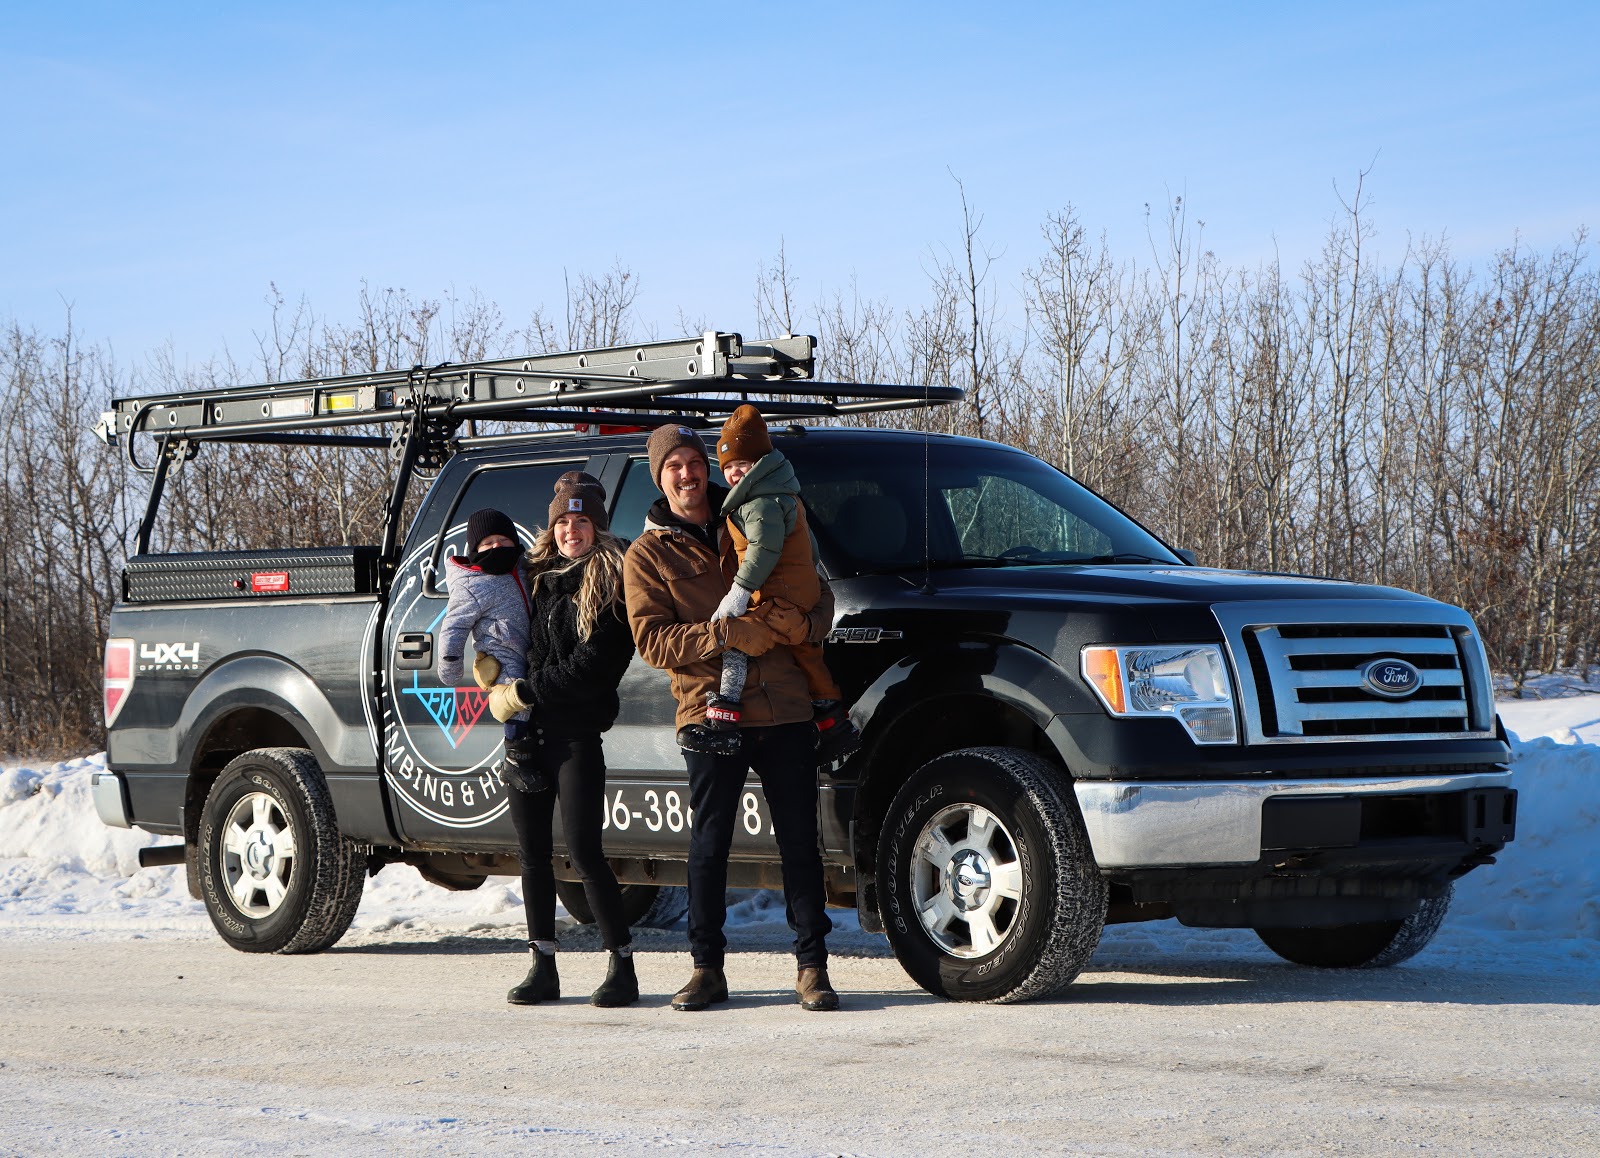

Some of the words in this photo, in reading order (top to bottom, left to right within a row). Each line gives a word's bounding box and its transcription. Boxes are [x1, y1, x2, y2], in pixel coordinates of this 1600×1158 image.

[828, 627, 883, 643] F-150
[140, 642, 200, 663] 4X4
[1383, 666, 1410, 683] Ford
[509, 751, 533, 760] SORE
[460, 781, 475, 806] &
[887, 784, 943, 934] GOODYEAR
[977, 827, 1034, 976] WRANGLER
